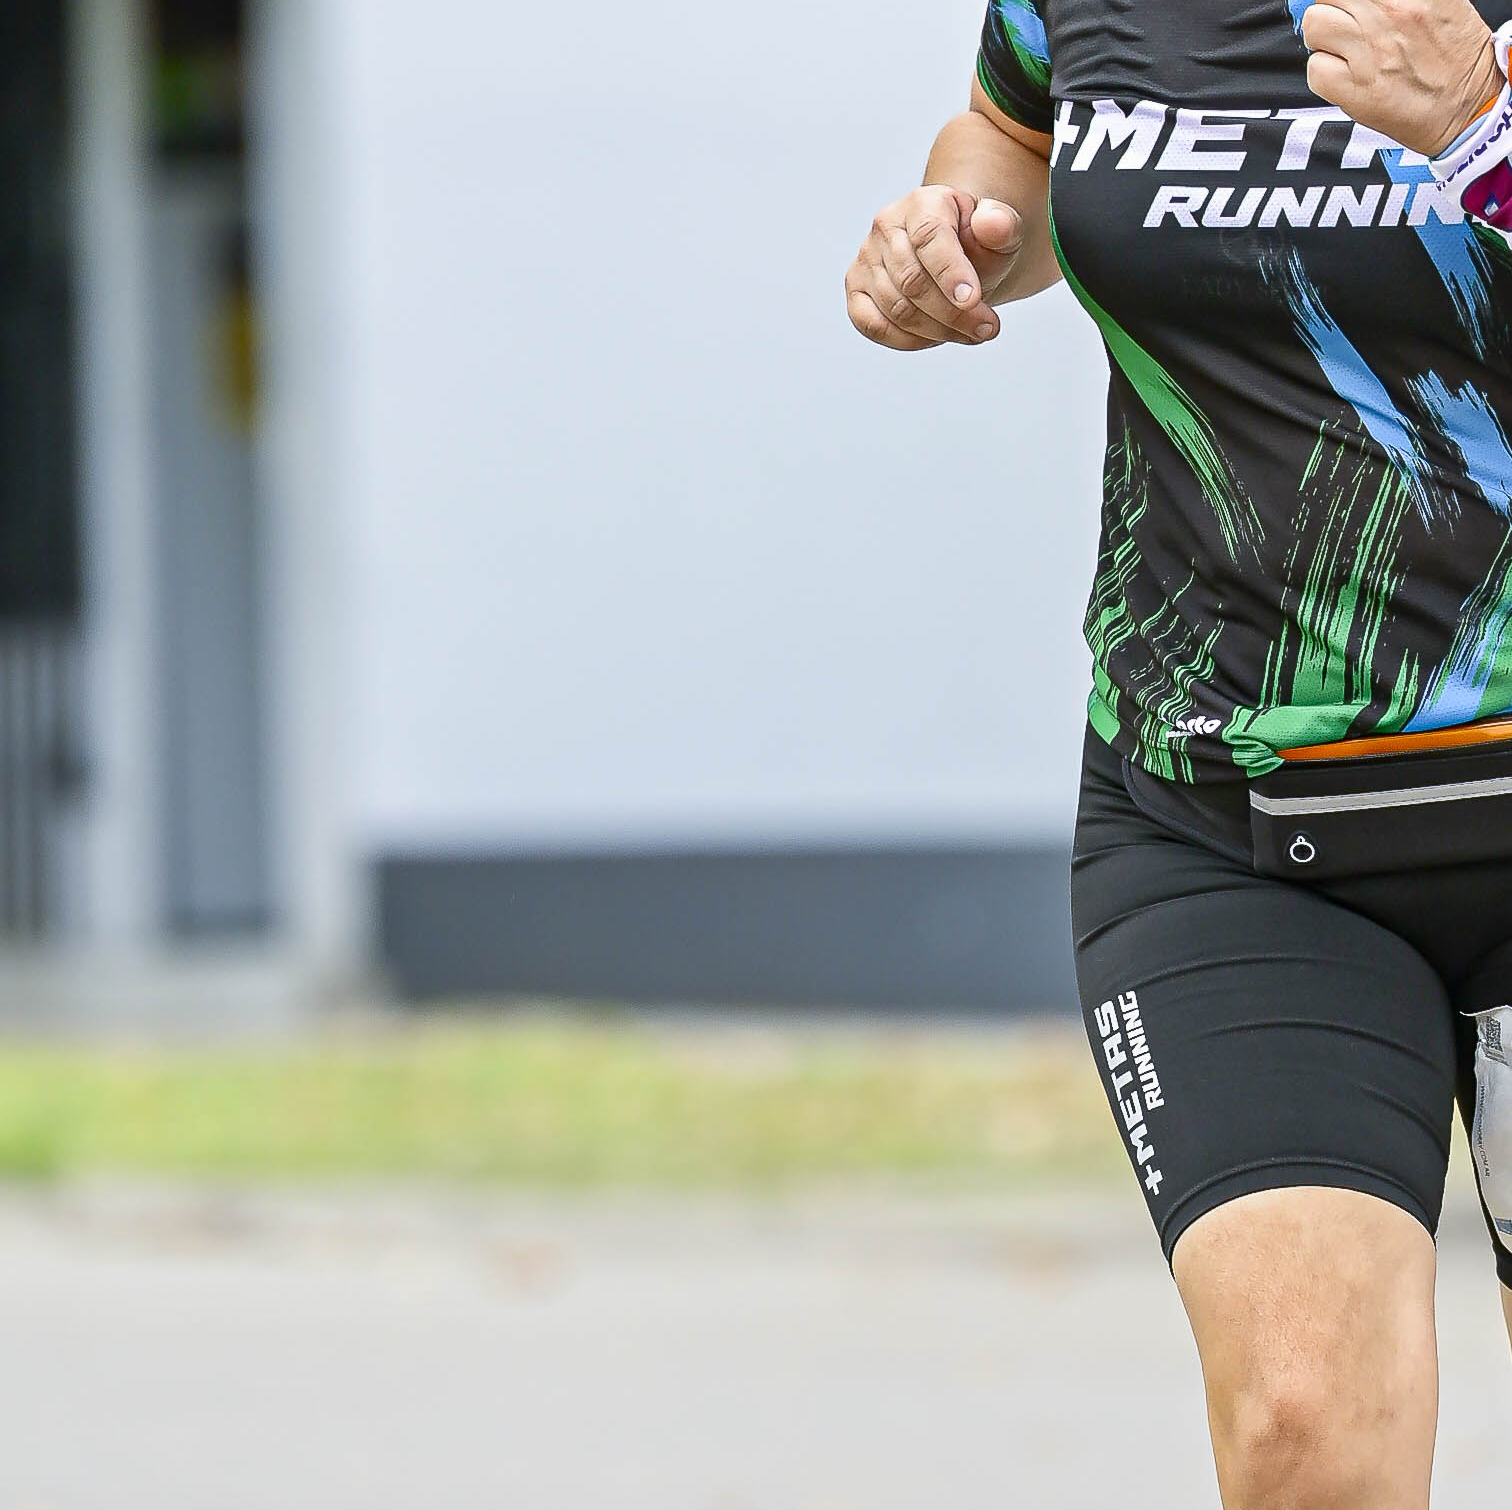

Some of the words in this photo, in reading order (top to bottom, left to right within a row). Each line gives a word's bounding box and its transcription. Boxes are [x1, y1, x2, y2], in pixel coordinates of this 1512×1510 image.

[1142, 183, 1466, 227] RUNNIN
[1094, 1000, 1163, 1195] +METAS
[1118, 991, 1164, 1110] RUNNING
